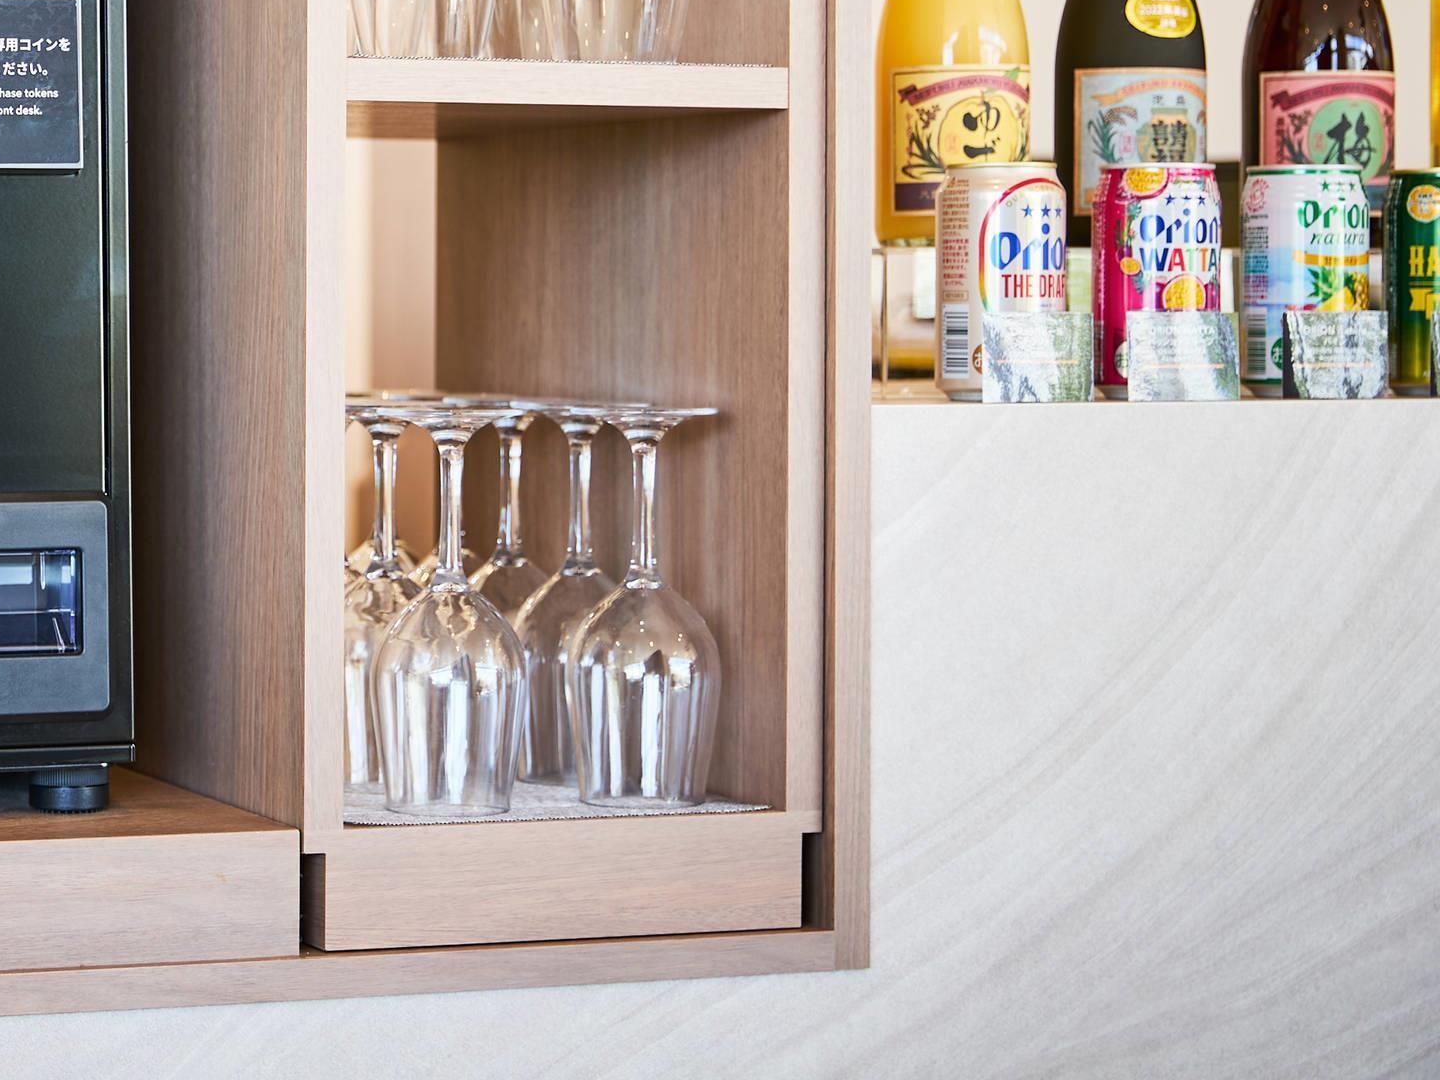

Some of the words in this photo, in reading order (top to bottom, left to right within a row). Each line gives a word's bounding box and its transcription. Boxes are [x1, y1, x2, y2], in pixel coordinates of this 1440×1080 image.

[24, 87, 59, 99] tokens
[15, 104, 43, 116] desk.
[1323, 112, 1376, 168] 梅
[1139, 207, 1219, 245] Orion
[990, 223, 1066, 271] Orio
[1310, 232, 1366, 246] naura
[1139, 247, 1219, 272] WATTA
[1001, 274, 1033, 299] THE
